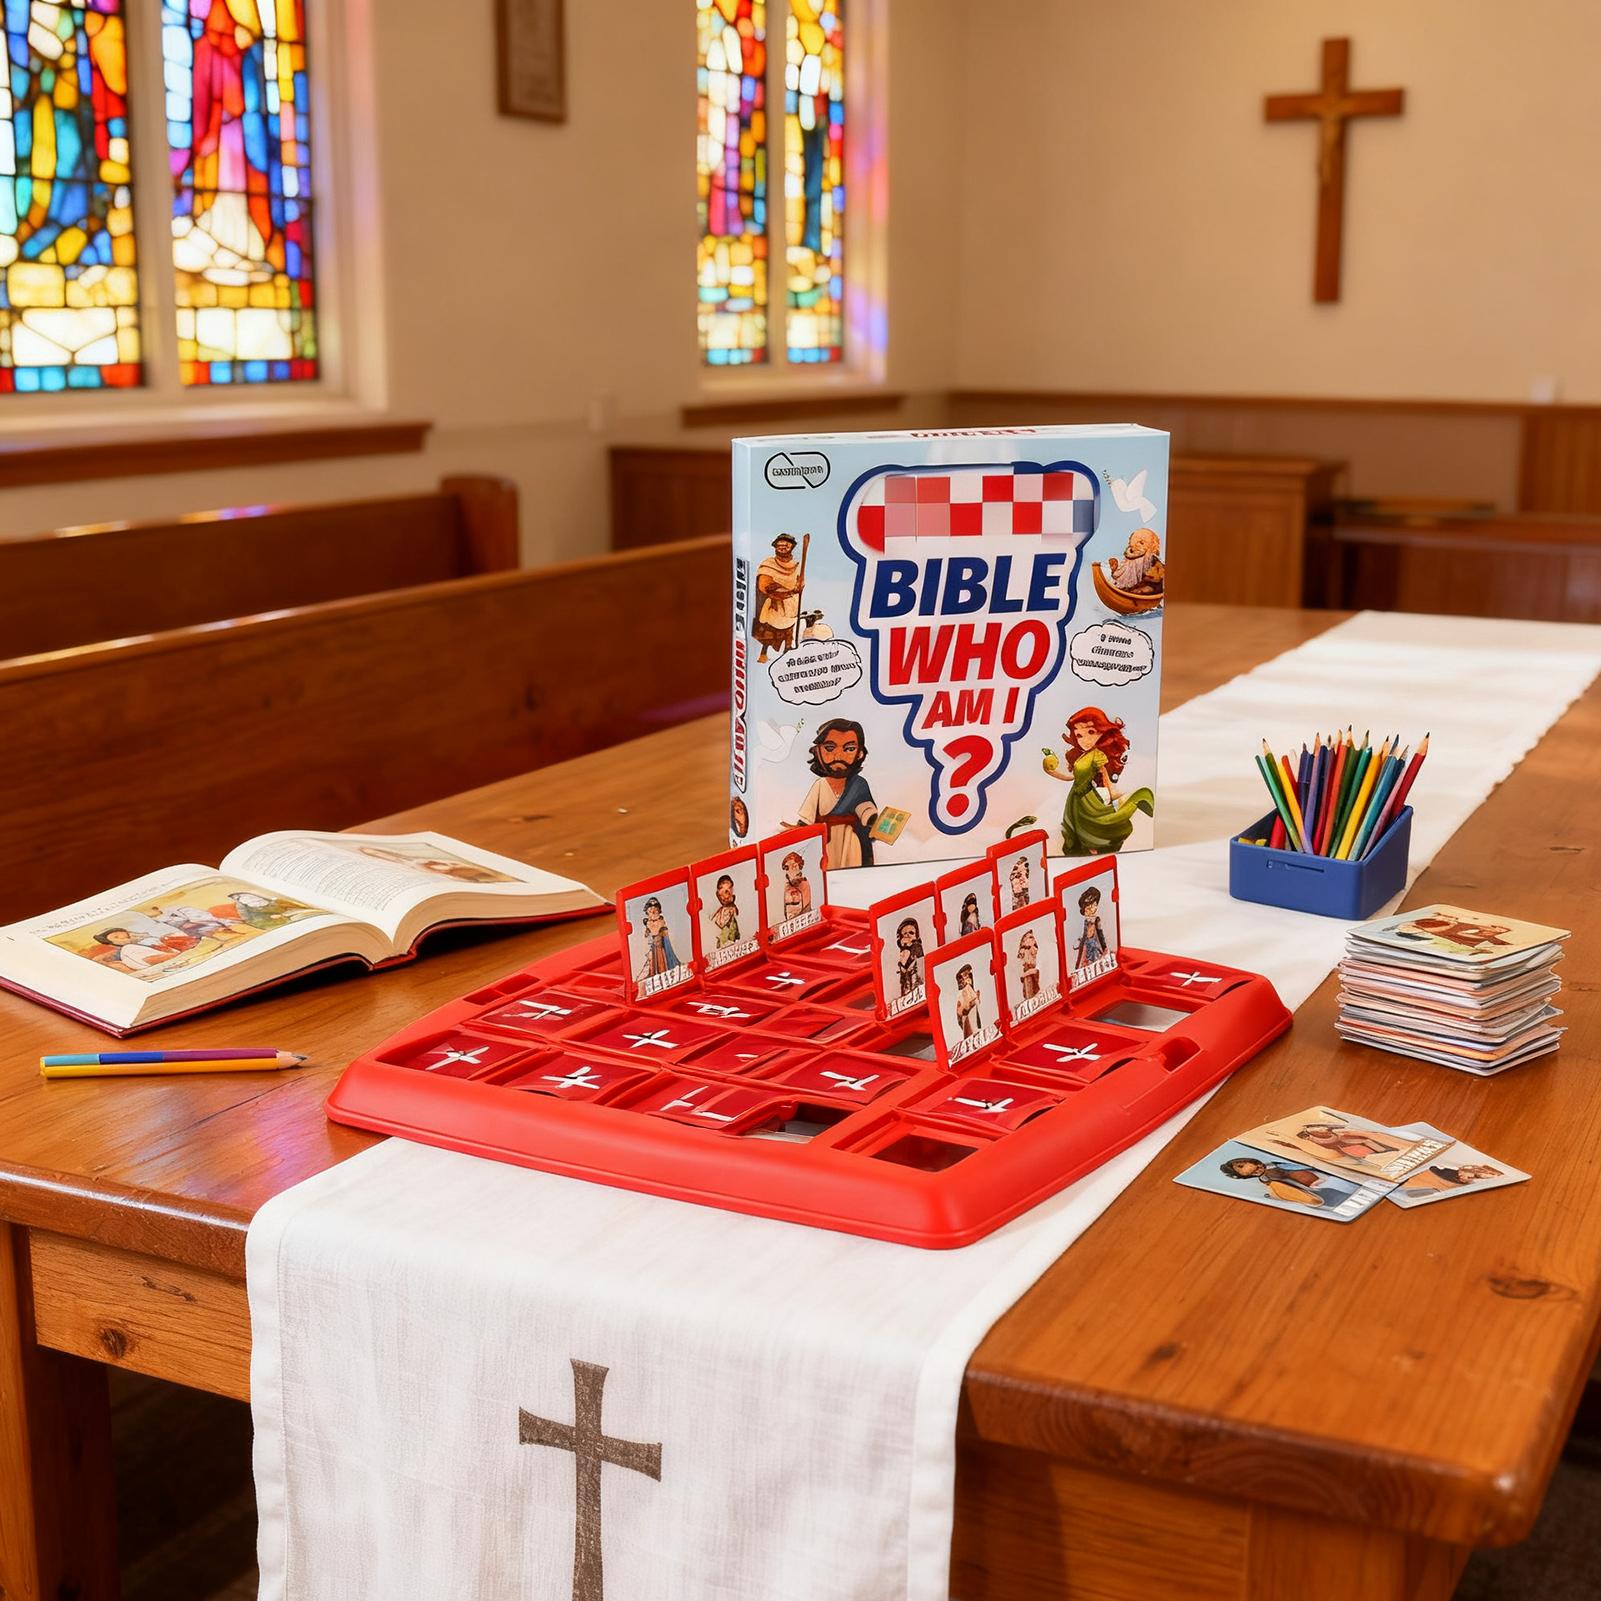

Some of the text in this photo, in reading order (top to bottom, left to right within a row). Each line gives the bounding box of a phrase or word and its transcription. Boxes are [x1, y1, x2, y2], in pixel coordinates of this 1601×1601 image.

[869, 553, 1067, 618] BIBLE
[889, 619, 1051, 686] WHO
[921, 687, 1020, 729] AM I
[943, 735, 994, 817] ?
